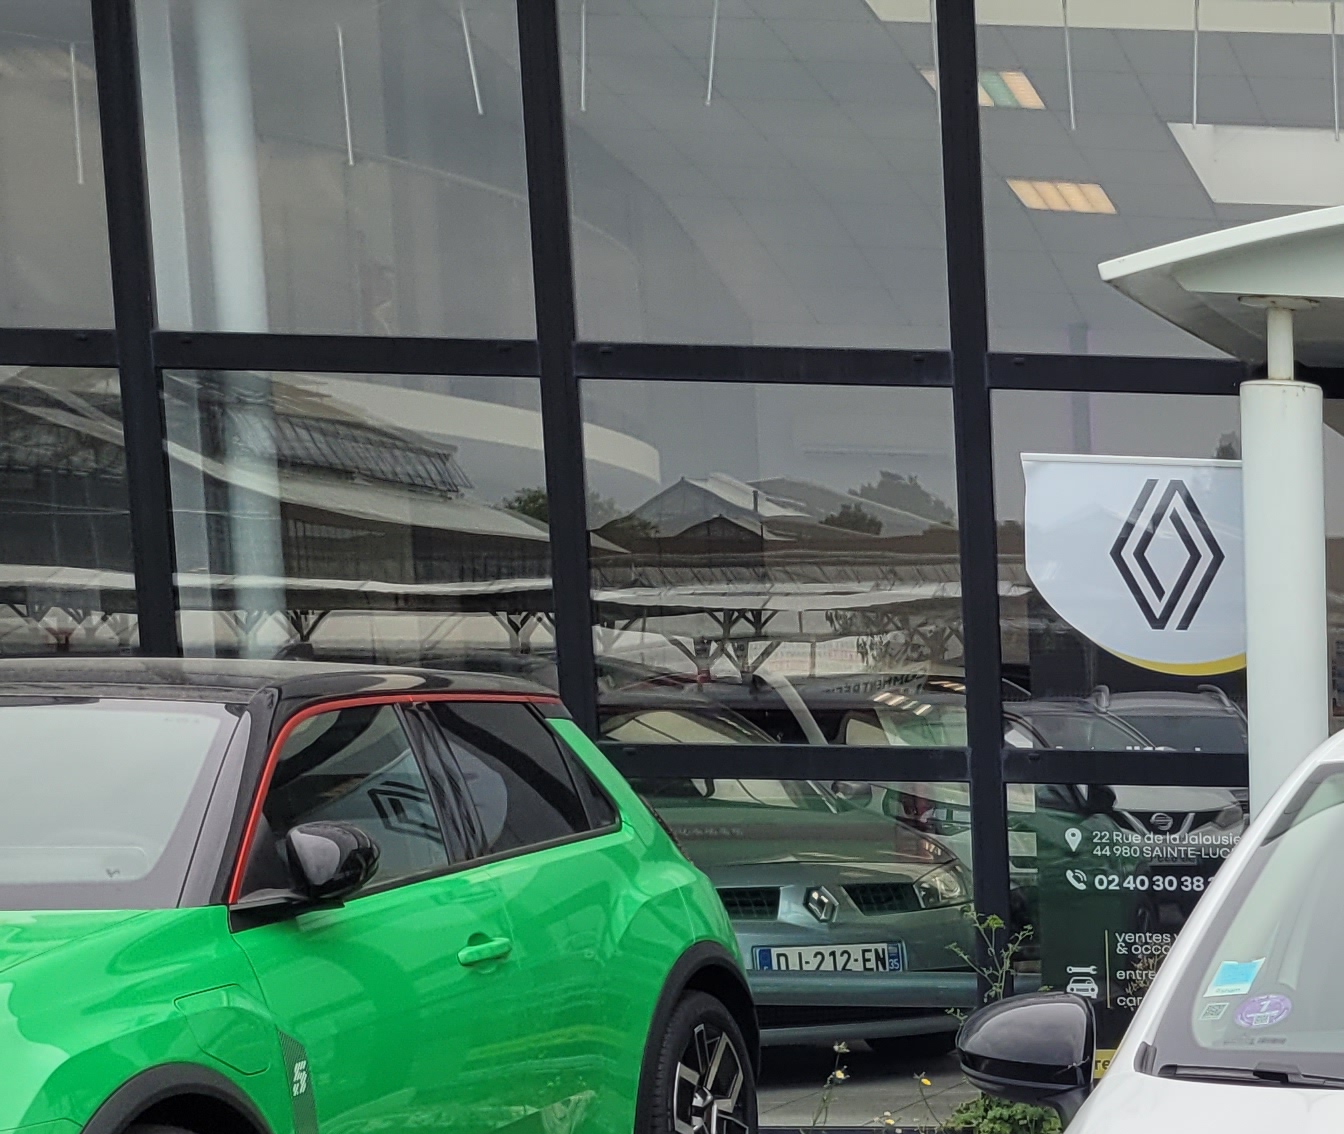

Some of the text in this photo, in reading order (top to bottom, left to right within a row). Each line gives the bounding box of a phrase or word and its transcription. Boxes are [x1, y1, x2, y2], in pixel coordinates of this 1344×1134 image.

[1092, 831, 1110, 843] 22
[1113, 832, 1141, 844] Rue
[1143, 832, 1164, 844] de
[1166, 833, 1180, 844] la
[1092, 846, 1234, 859] 44 980 SAINTE-LUC
[1094, 874, 1120, 890] 02
[1122, 874, 1149, 890] 40
[1152, 875, 1178, 891] 30
[1180, 875, 1205, 891] 38
[1115, 932, 1171, 944] ventes
[1116, 943, 1128, 954] &
[1116, 968, 1157, 980] entre
[1116, 996, 1142, 1008] car
